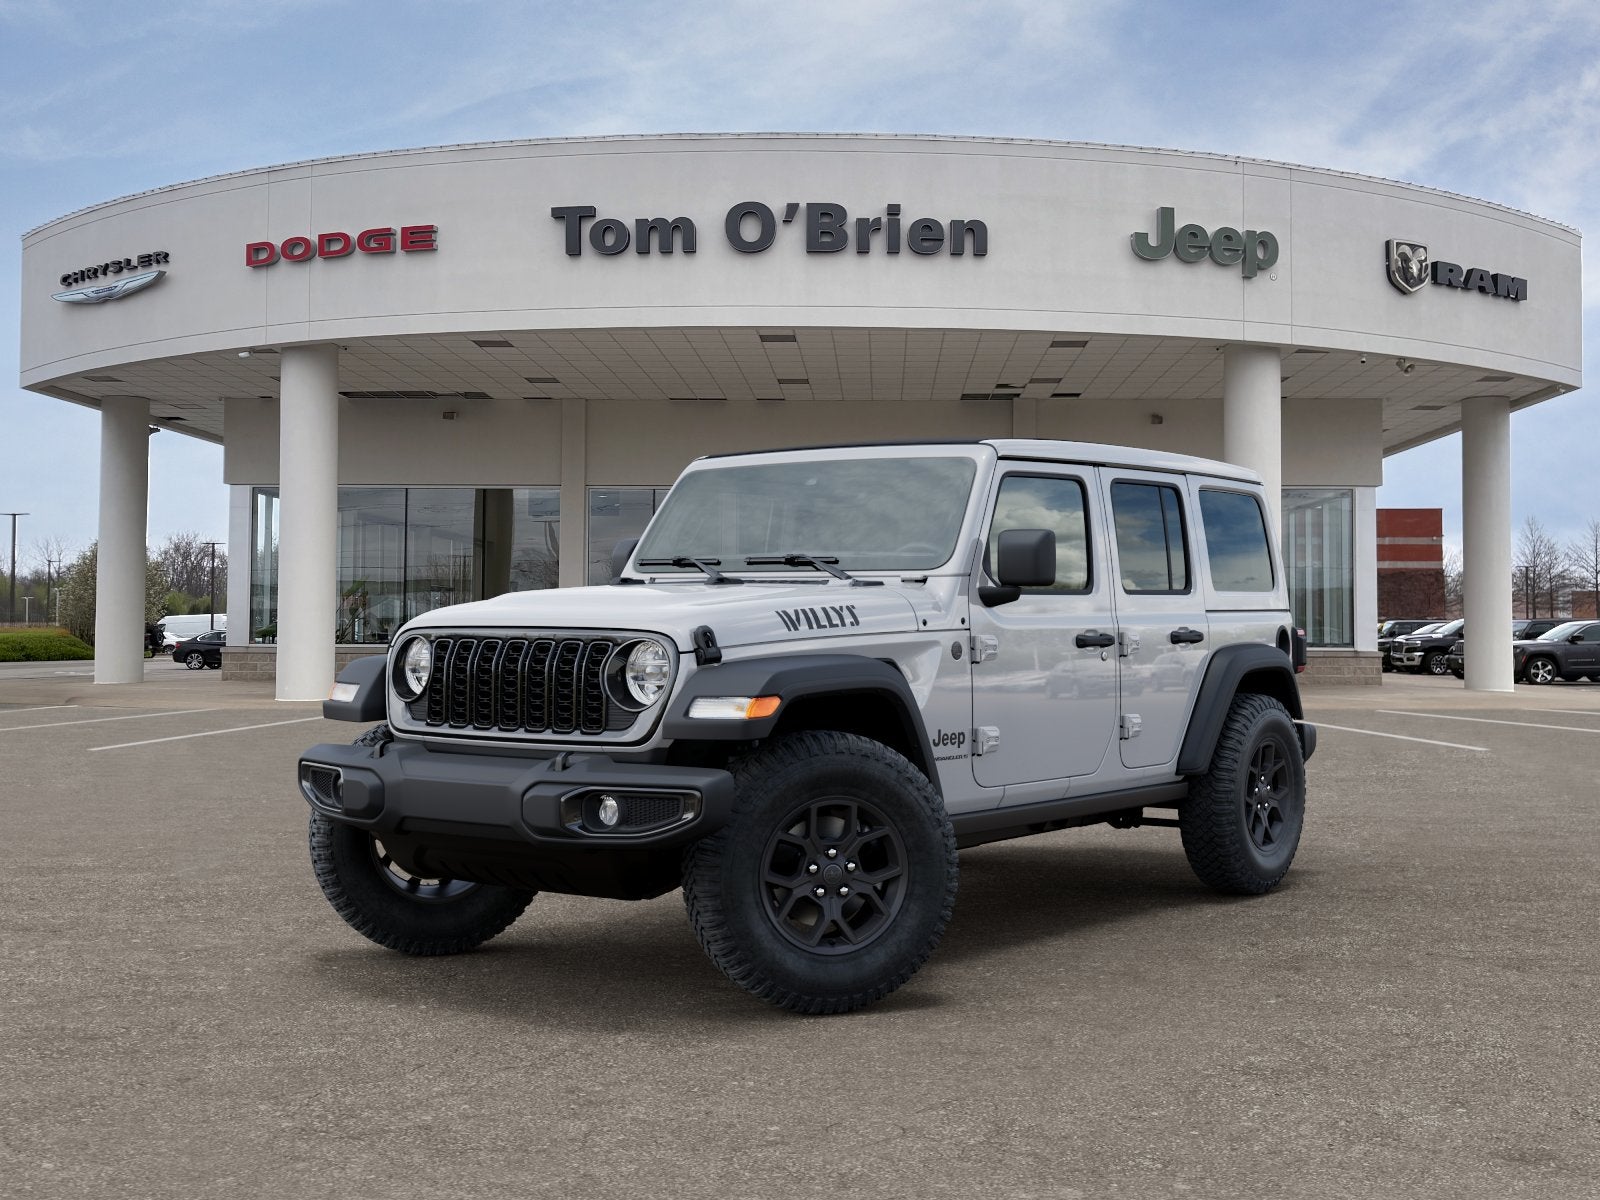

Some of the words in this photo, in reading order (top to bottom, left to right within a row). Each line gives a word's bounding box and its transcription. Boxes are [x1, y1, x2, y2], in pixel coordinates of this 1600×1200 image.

[245, 224, 438, 268] DODGE
[551, 205, 697, 256] Tom
[725, 201, 988, 257] O'Brien
[1130, 207, 1279, 278] Jeep
[60, 250, 170, 286] CHRYSLER
[1431, 260, 1528, 301] RAM
[775, 604, 860, 632] WILLYS
[932, 728, 966, 748] Jeep
